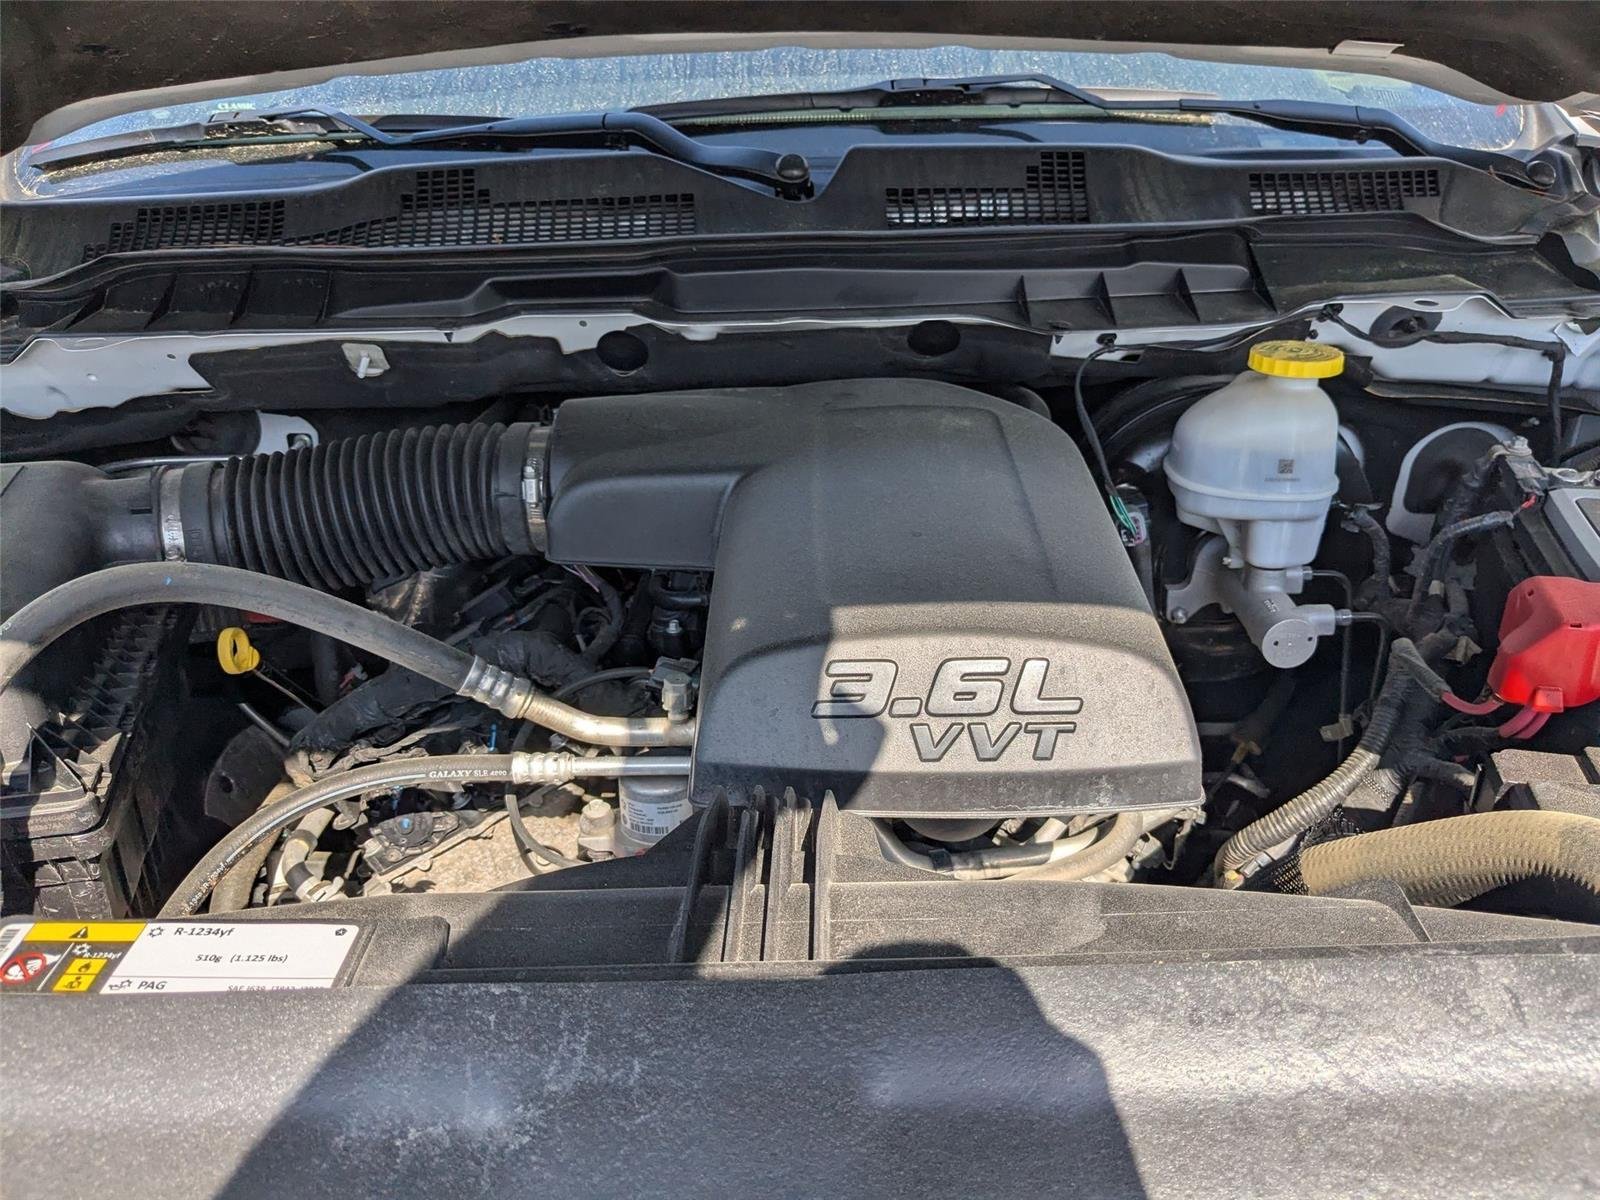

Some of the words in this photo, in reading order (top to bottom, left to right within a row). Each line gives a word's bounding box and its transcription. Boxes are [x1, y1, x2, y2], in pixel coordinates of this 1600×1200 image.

[811, 657, 1084, 719] 3.6L
[910, 722, 1078, 762] VVT
[429, 770, 472, 778] GALAXY
[173, 927, 236, 937] R-1234yf
[83, 951, 122, 960] R-1234yf
[195, 954, 222, 963] 510g
[229, 954, 266, 963] (1.125
[267, 954, 289, 963] lbs)
[137, 981, 168, 990] PAG
